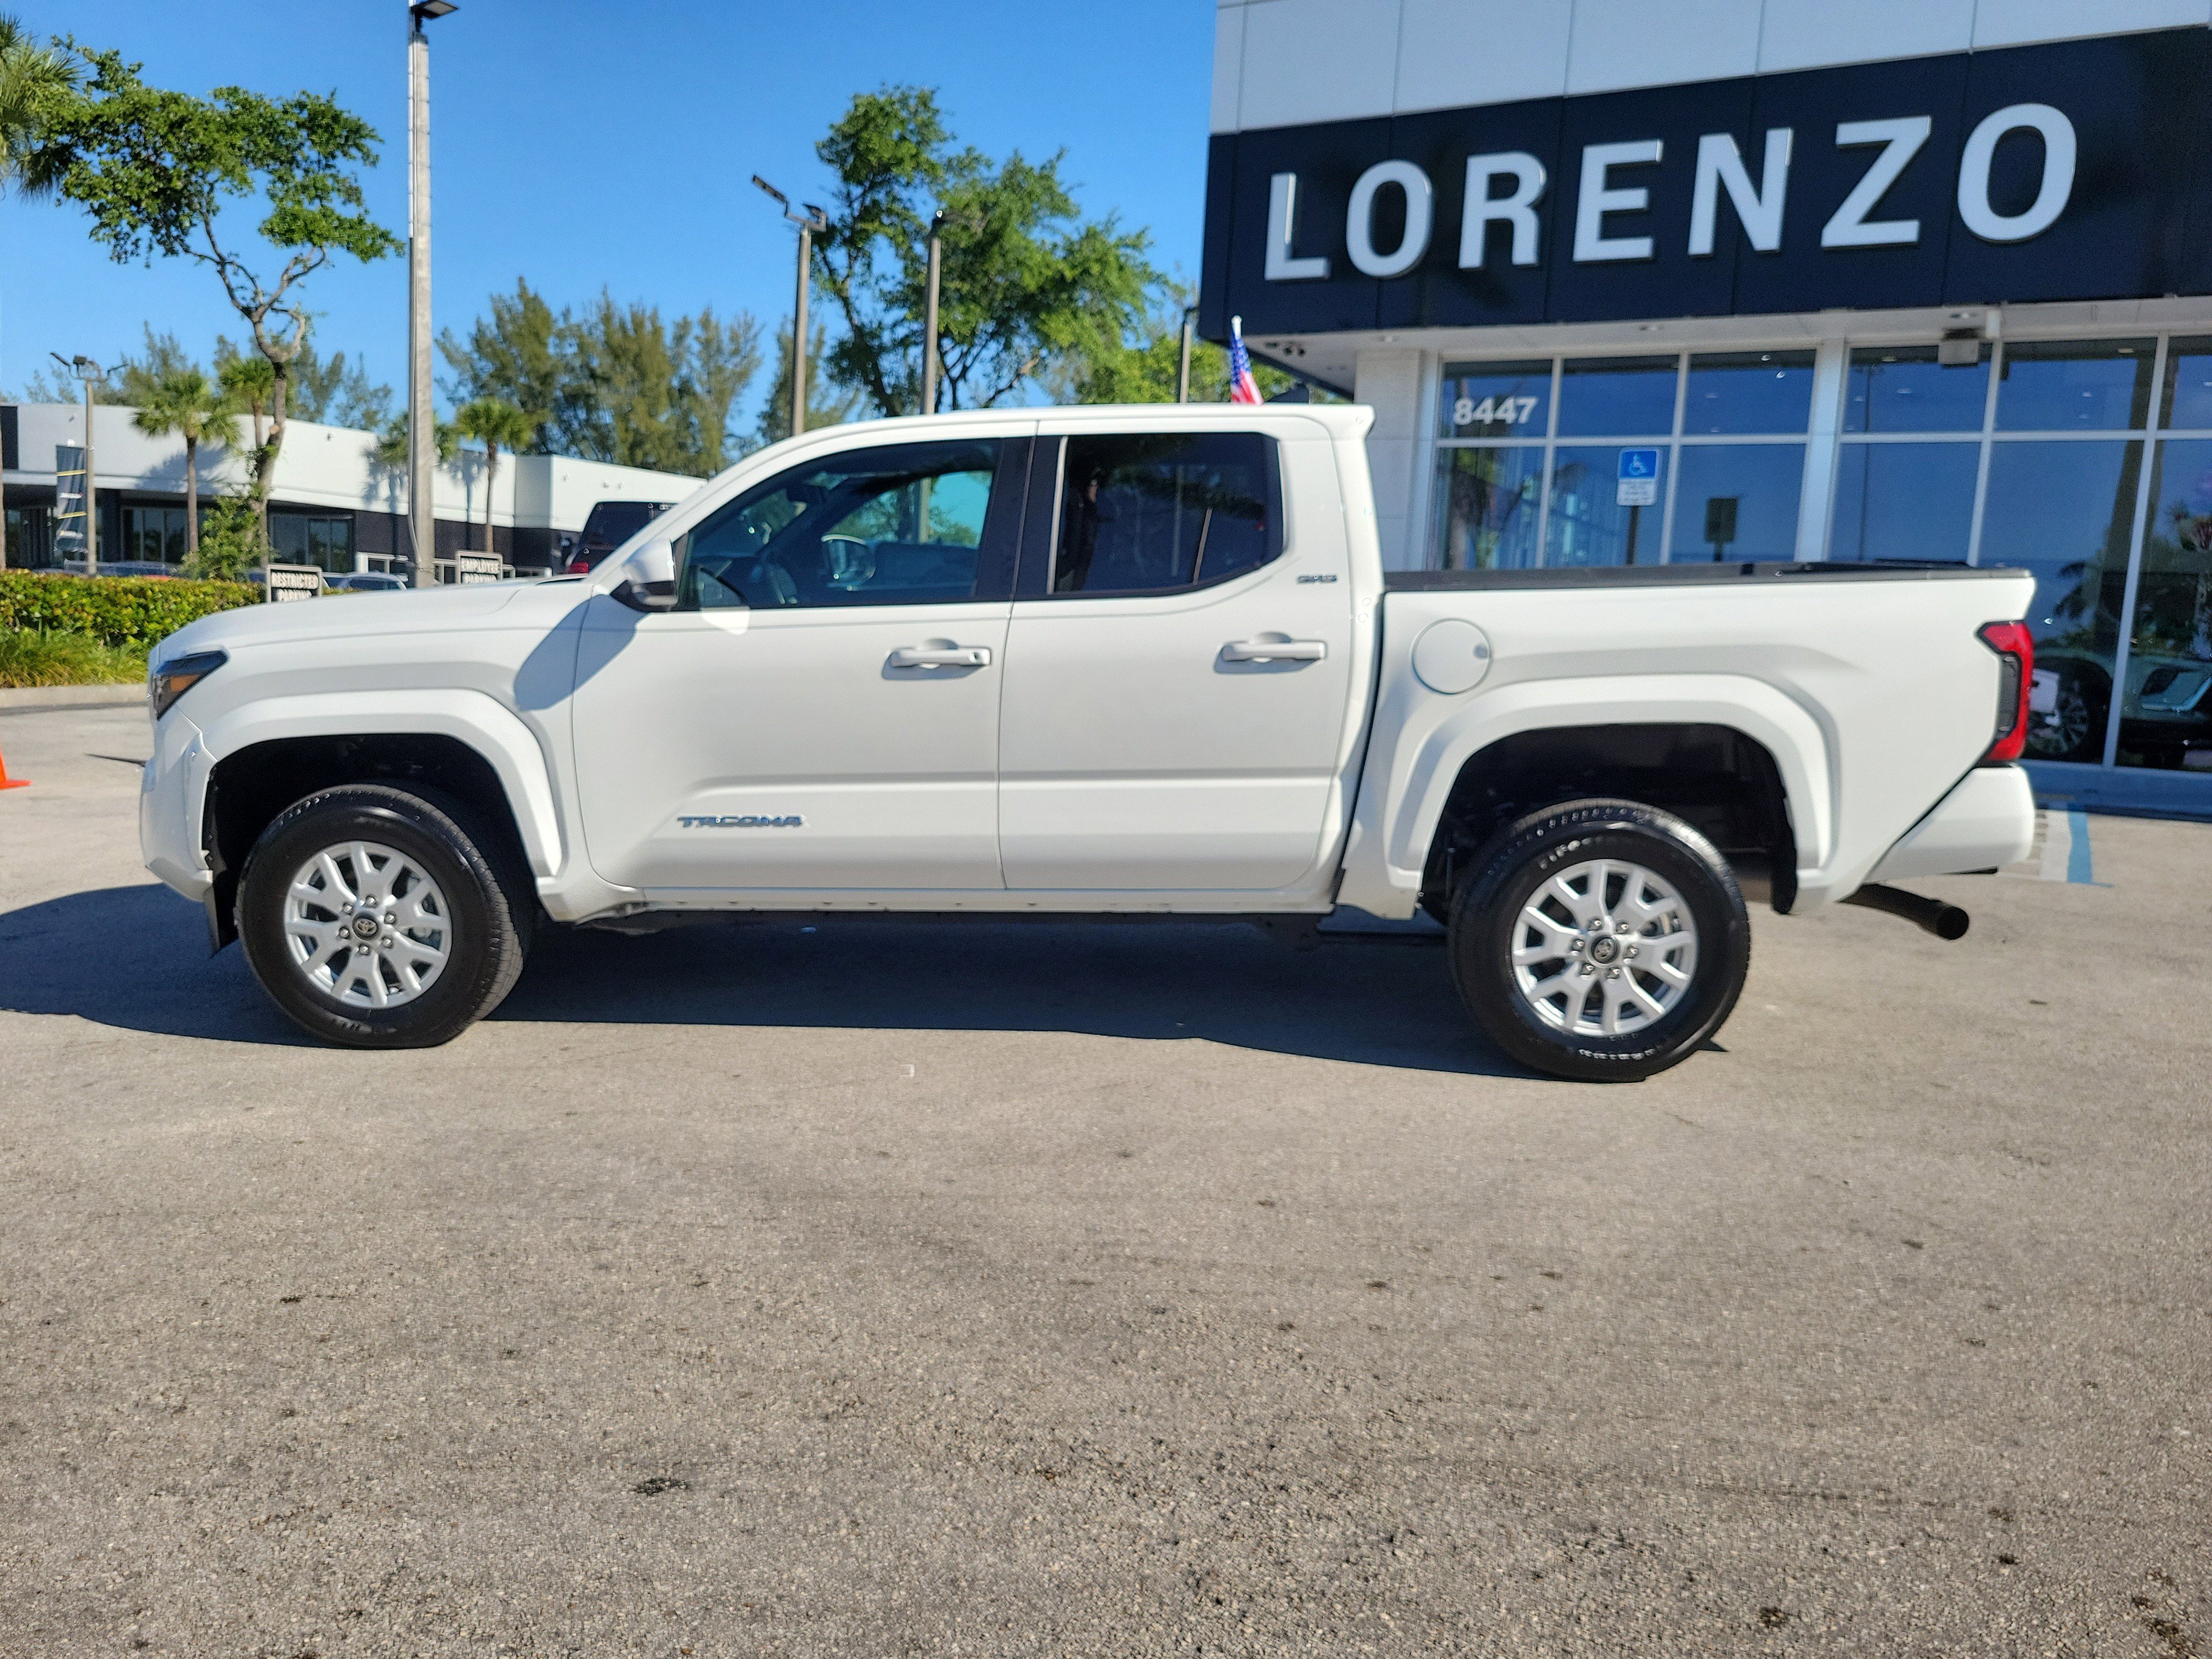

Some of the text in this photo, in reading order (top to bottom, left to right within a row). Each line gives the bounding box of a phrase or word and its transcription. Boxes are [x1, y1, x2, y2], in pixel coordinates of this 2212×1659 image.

[1264, 103, 2077, 280] LORENZO
[1454, 397, 1538, 425] 8447
[461, 557, 500, 574] EMPLOYEE
[271, 572, 318, 589] RESTRICTED
[677, 816, 803, 828] TACOMA
